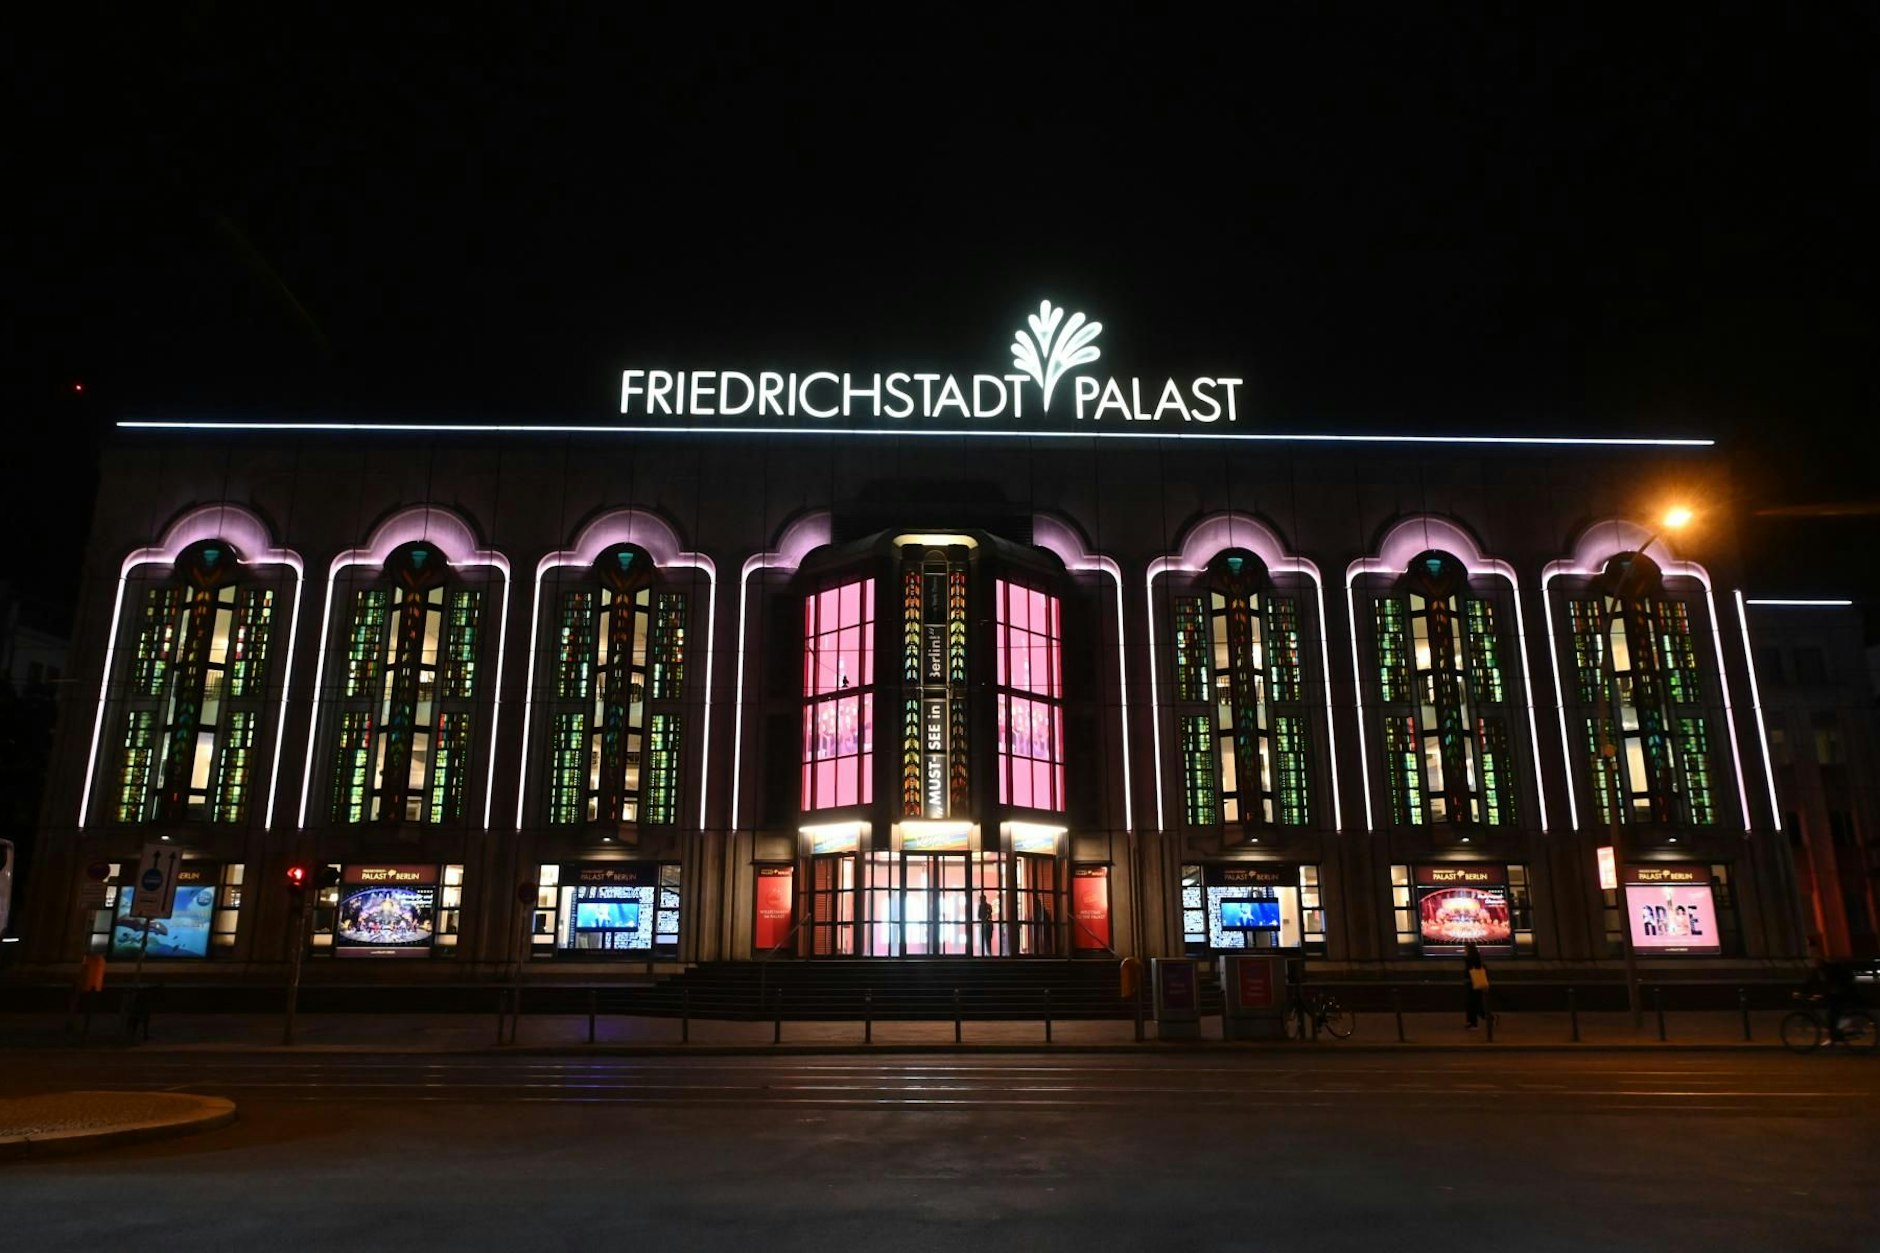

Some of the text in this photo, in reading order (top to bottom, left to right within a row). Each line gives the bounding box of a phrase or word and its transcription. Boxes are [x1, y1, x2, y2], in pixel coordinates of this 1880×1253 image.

[620, 369, 1244, 422] FRIEDRICHSTADT PALAST
[361, 872, 420, 880] PALAST BERLIN
[580, 873, 637, 881] PALAST BERLIN
[1223, 873, 1280, 881] PALAST BERLIN
[1465, 873, 1488, 881] BERLIN
[1670, 873, 1693, 881] BERLIN
